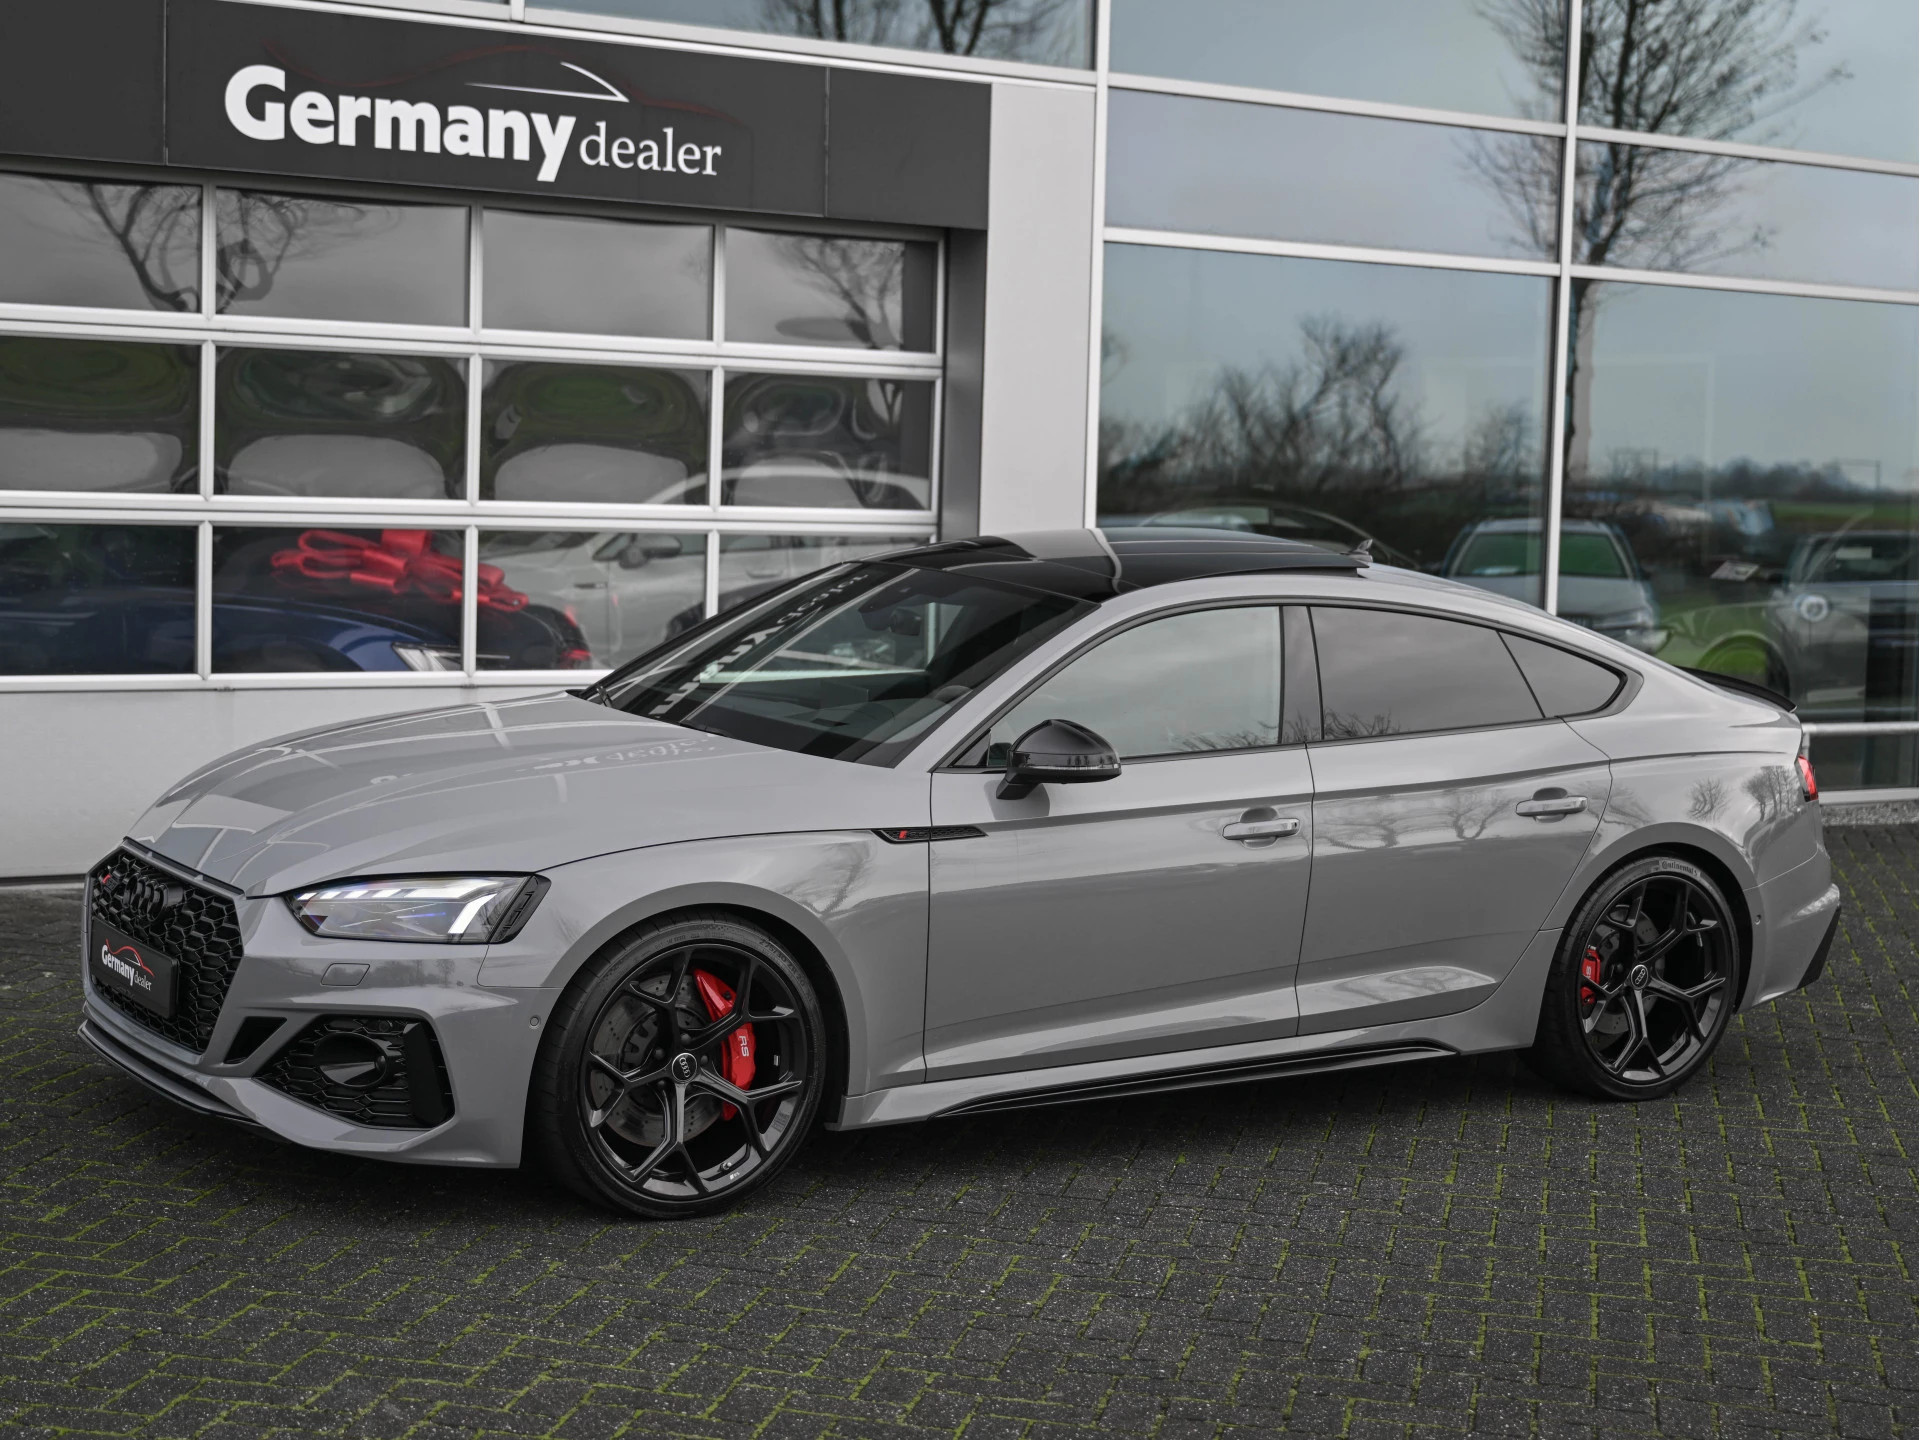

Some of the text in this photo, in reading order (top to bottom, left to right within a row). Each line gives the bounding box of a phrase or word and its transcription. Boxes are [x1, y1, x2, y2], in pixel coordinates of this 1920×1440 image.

[224, 65, 722, 183] Germany dealer
[102, 945, 152, 990] Germany dealer
[739, 1036, 749, 1056] RS
